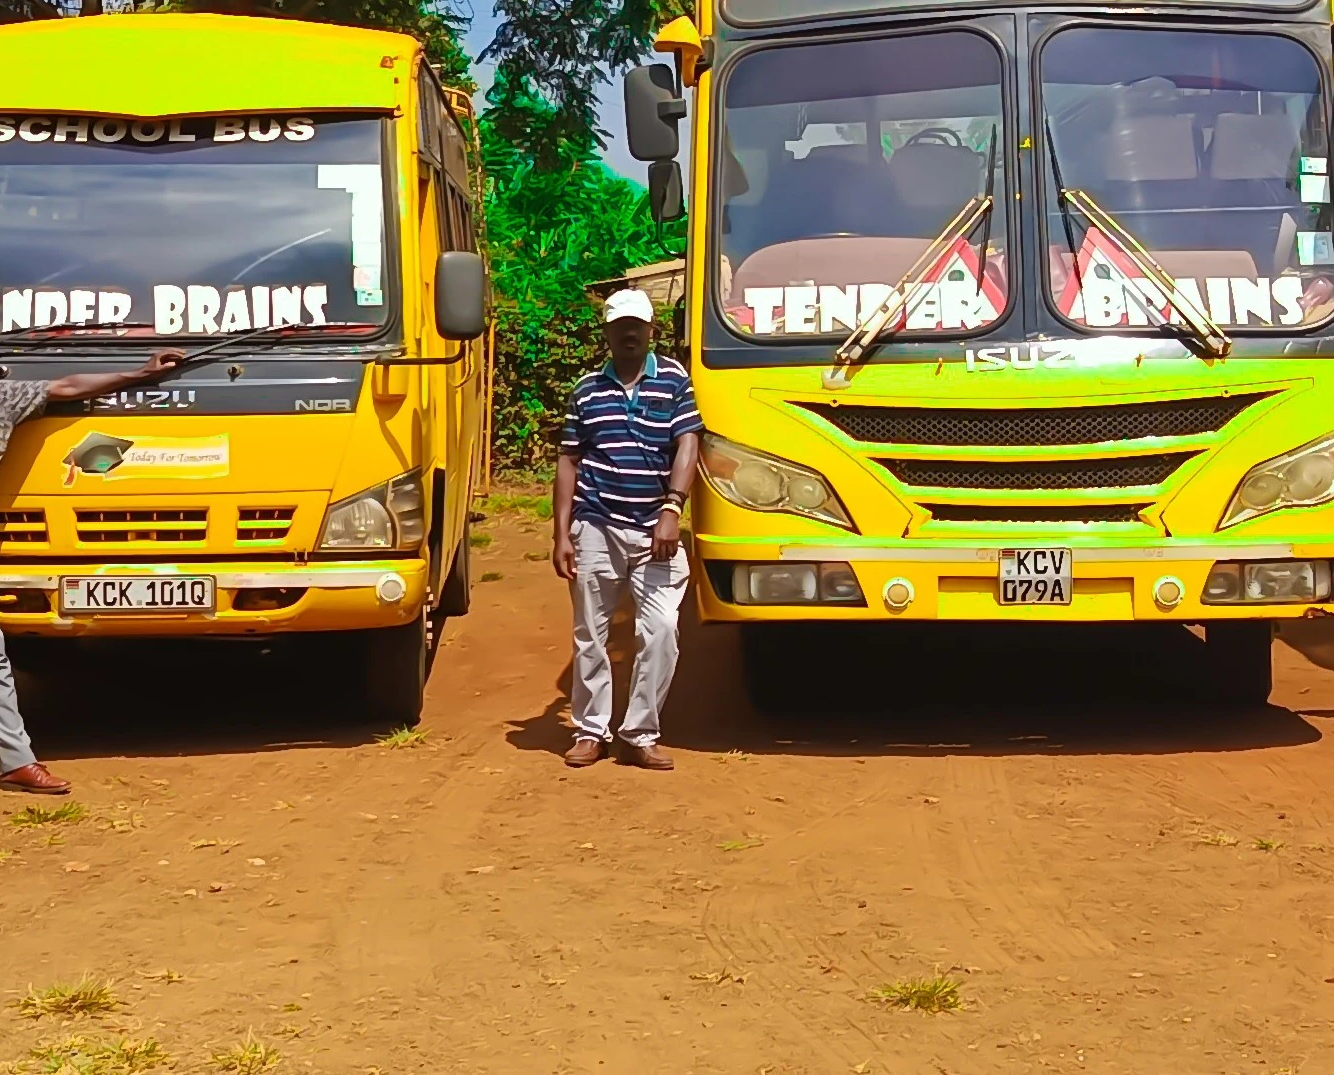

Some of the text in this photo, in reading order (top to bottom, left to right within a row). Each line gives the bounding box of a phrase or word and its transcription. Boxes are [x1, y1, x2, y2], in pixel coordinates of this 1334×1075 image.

[213, 117, 315, 142] BUS
[153, 284, 329, 336] BRAINS
[744, 276, 1306, 334] TENDER BRAINS
[965, 343, 1103, 373] ISUZ
[294, 399, 352, 411] NQR
[1016, 550, 1065, 575] KCV
[86, 580, 206, 606] KCK 101Q
[1003, 578, 1065, 602] 079A
